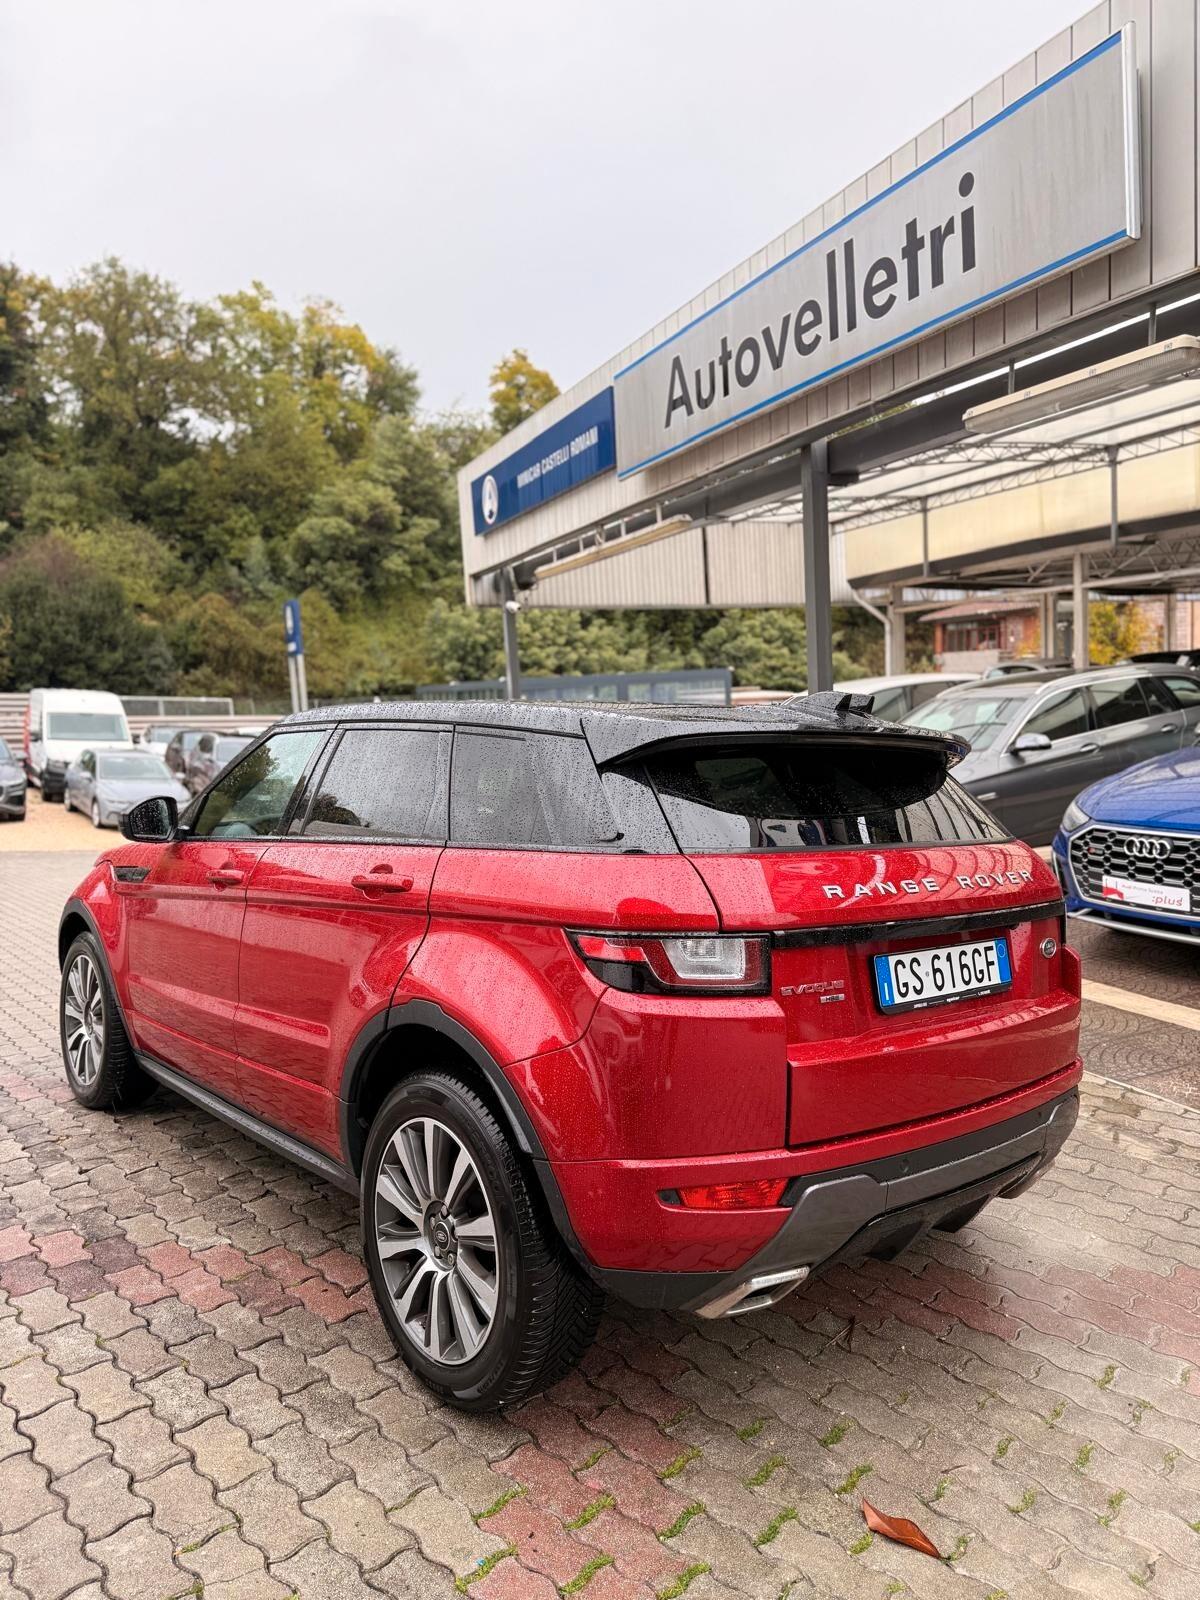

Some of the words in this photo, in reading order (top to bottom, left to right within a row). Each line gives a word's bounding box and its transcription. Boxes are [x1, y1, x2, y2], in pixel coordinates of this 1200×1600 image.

[664, 171, 976, 429] Autovelletri
[541, 444, 570, 475] CASTELLI
[570, 425, 599, 458] ROMANI
[821, 877, 941, 899] RANGE
[955, 869, 1034, 889] ROVER
[780, 979, 845, 996] EVOQUE
